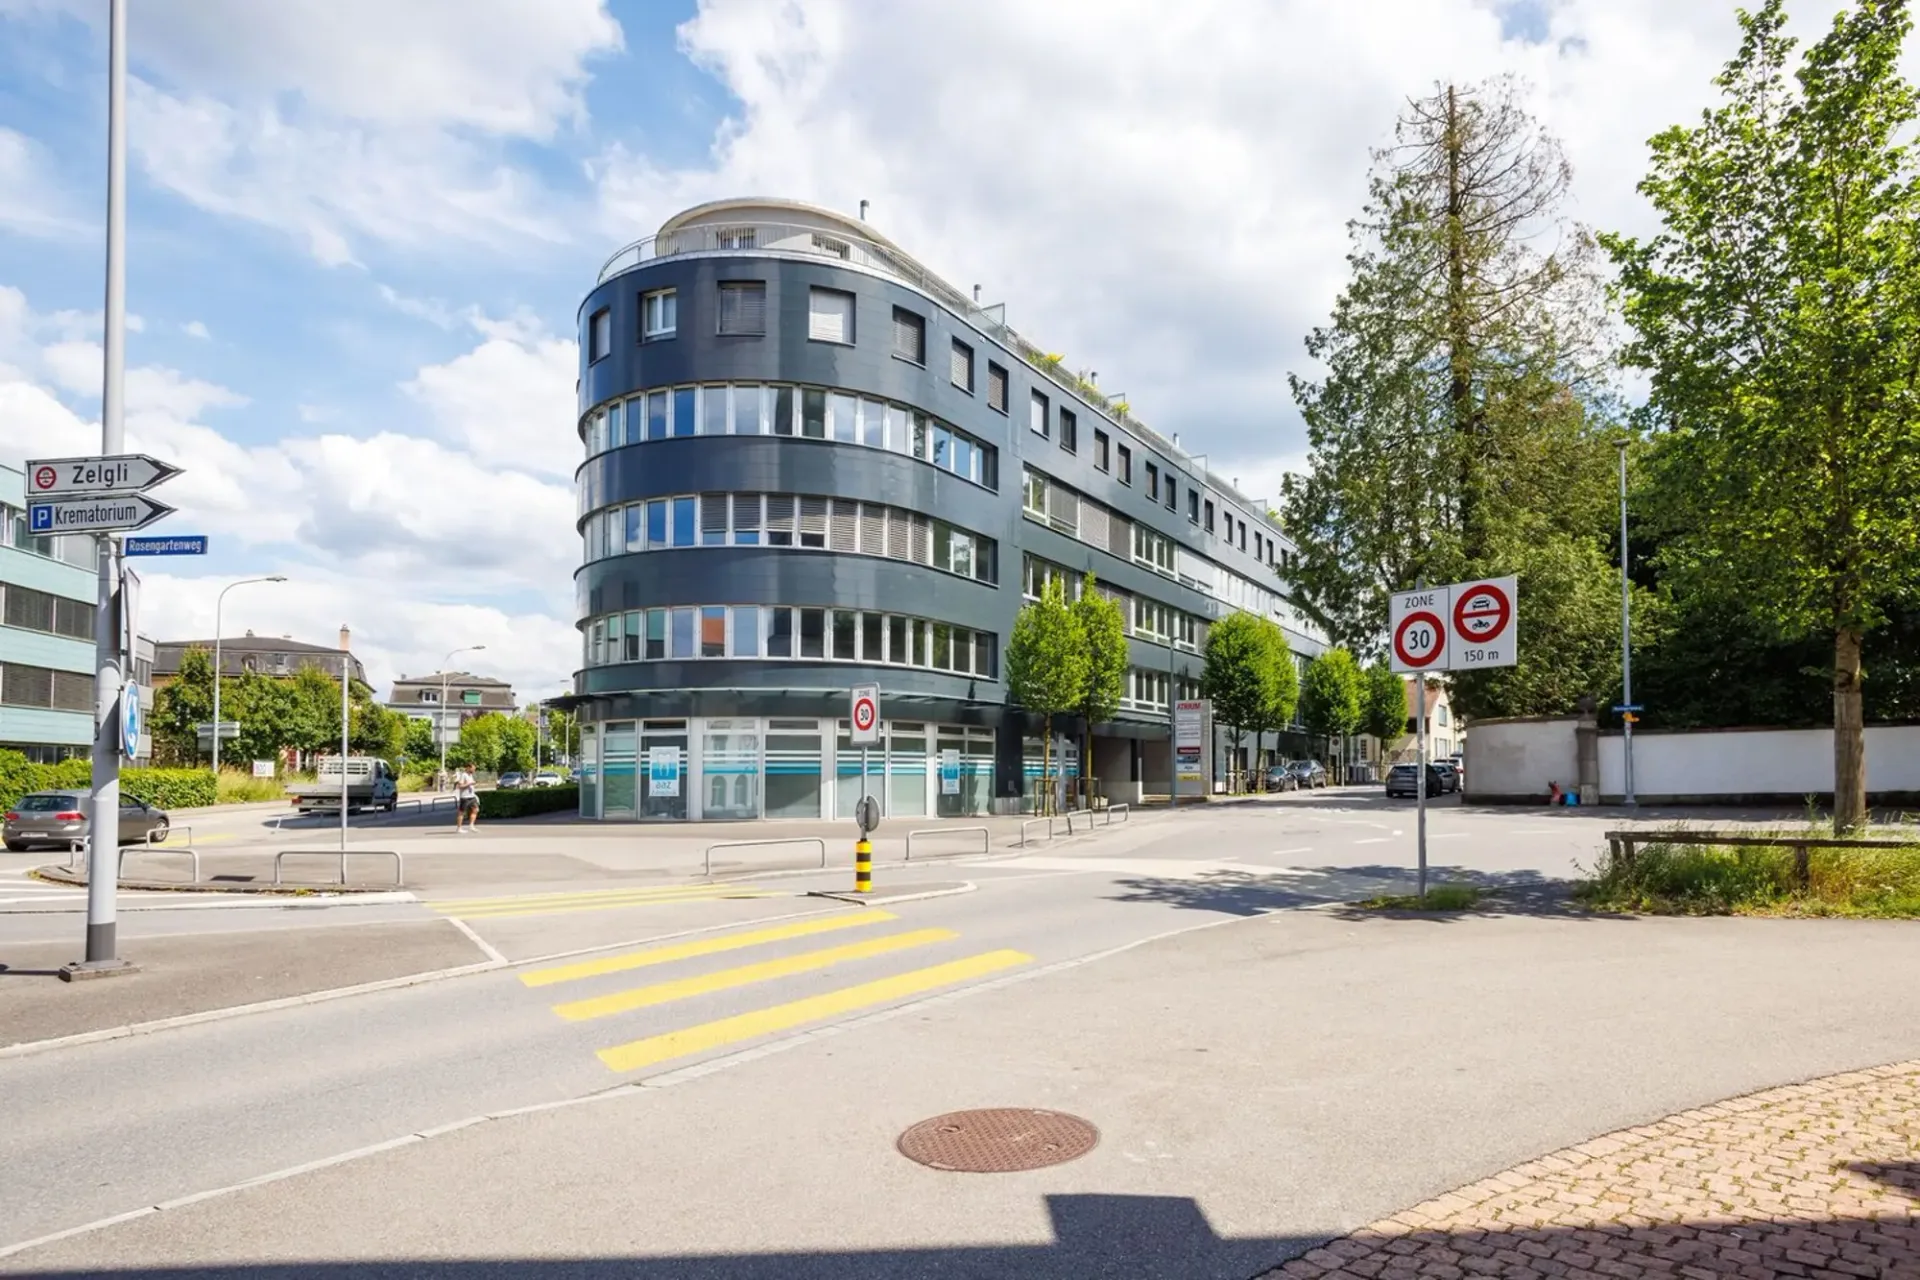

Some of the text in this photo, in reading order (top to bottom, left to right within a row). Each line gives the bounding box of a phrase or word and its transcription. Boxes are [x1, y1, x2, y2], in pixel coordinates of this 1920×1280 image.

[72, 463, 128, 487] Zelgli
[37, 503, 137, 527] P Krematorium
[128, 537, 202, 554] Rosengartenweg
[1404, 594, 1435, 609] ZONE
[1408, 629, 1430, 650] 30
[1463, 649, 1499, 662] 150 m
[860, 708, 869, 721] 30
